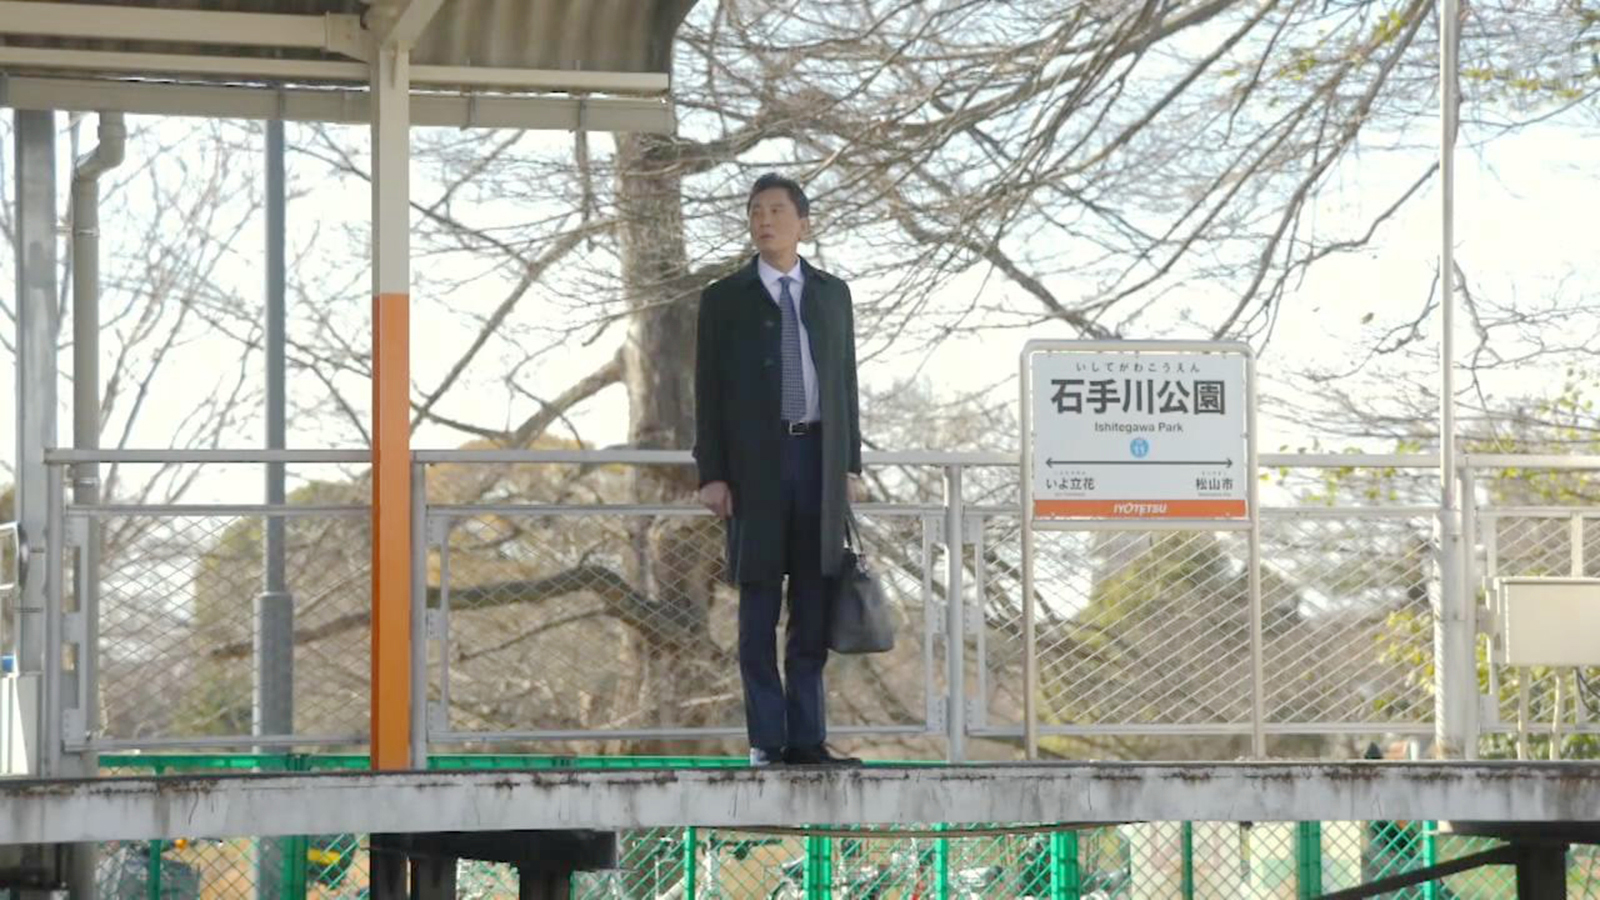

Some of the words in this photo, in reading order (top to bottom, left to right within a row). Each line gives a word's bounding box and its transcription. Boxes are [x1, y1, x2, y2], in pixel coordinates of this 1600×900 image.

[1076, 361, 1200, 373] いしてがわこうえん
[1050, 379, 1226, 415] 石手川公園
[1094, 422, 1155, 434] Ishitegawa
[1158, 422, 1184, 432] Park
[1045, 477, 1095, 490] いよ立花
[1195, 477, 1234, 491] 松山市
[1113, 502, 1168, 515] IYOTETSU
